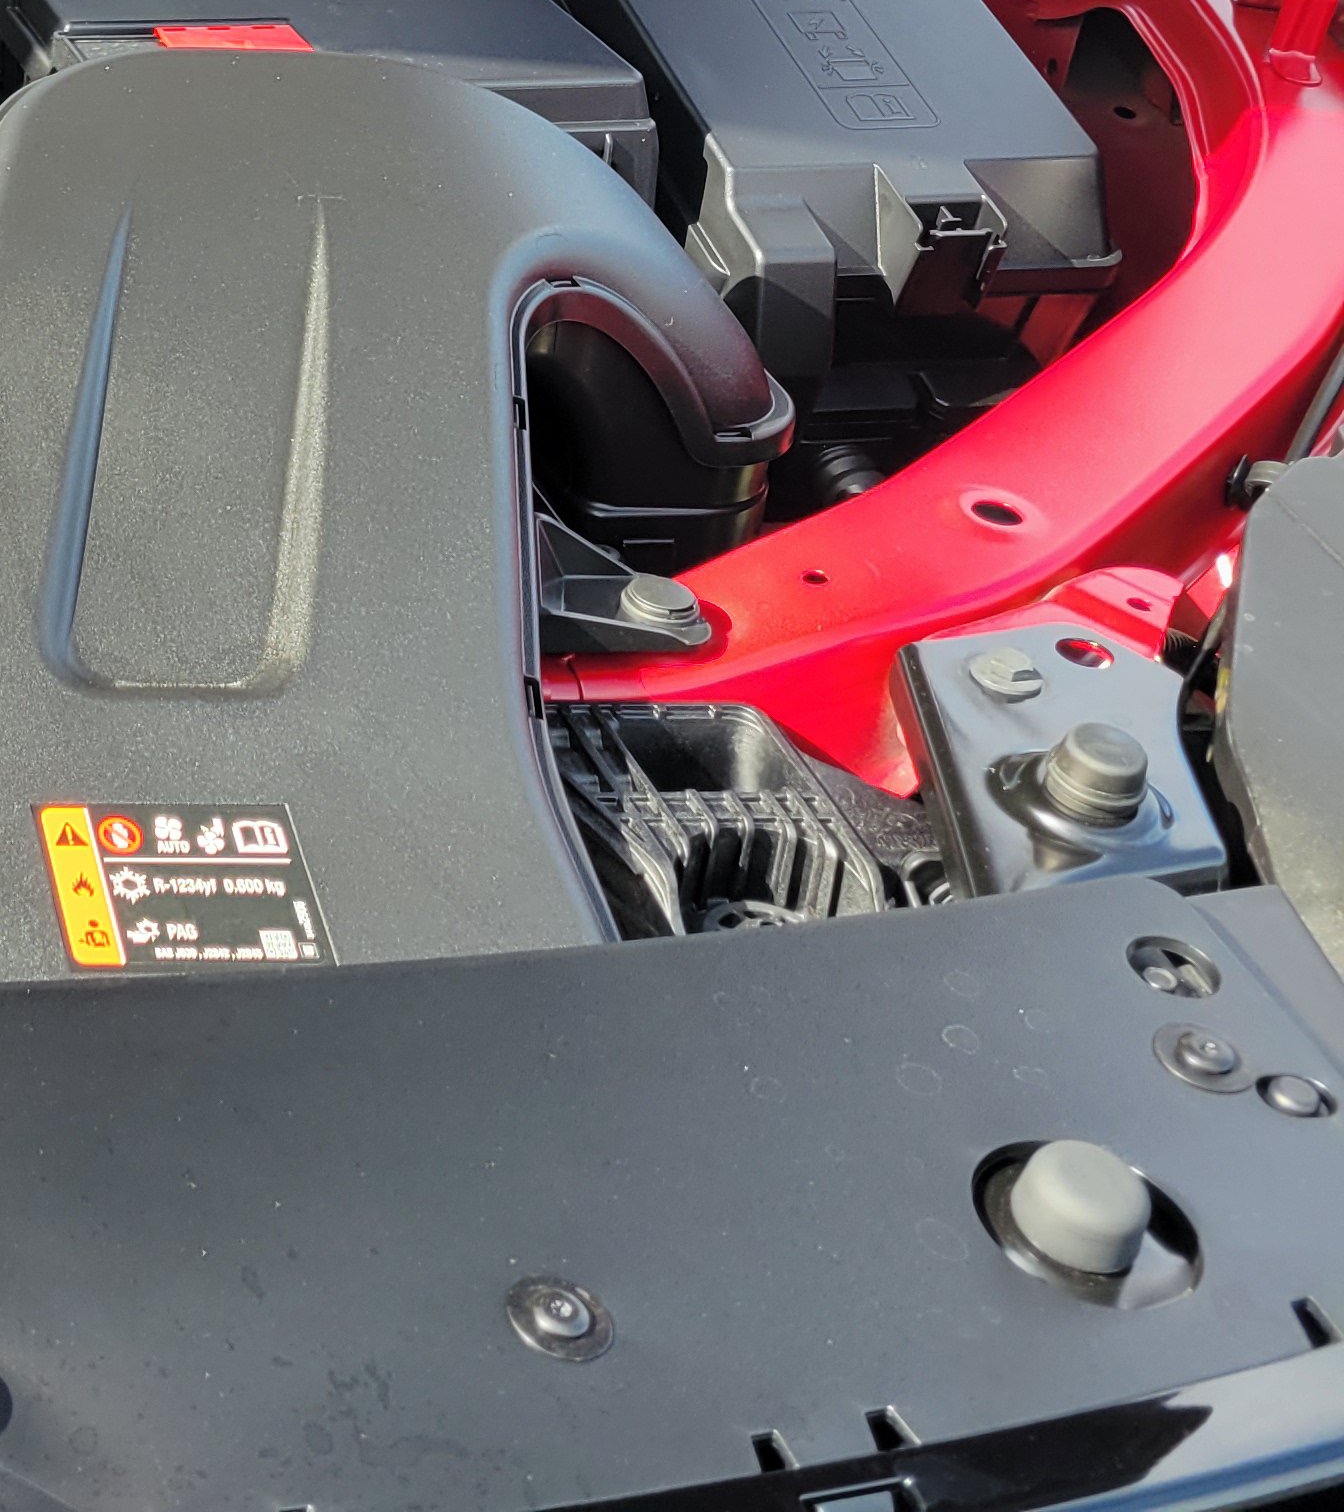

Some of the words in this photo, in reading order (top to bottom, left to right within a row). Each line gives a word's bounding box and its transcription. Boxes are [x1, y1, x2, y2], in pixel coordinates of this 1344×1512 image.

[157, 840, 190, 854] AUTO
[153, 877, 217, 897] R-1234yf
[264, 877, 286, 897] kg
[166, 923, 199, 941] PAG
